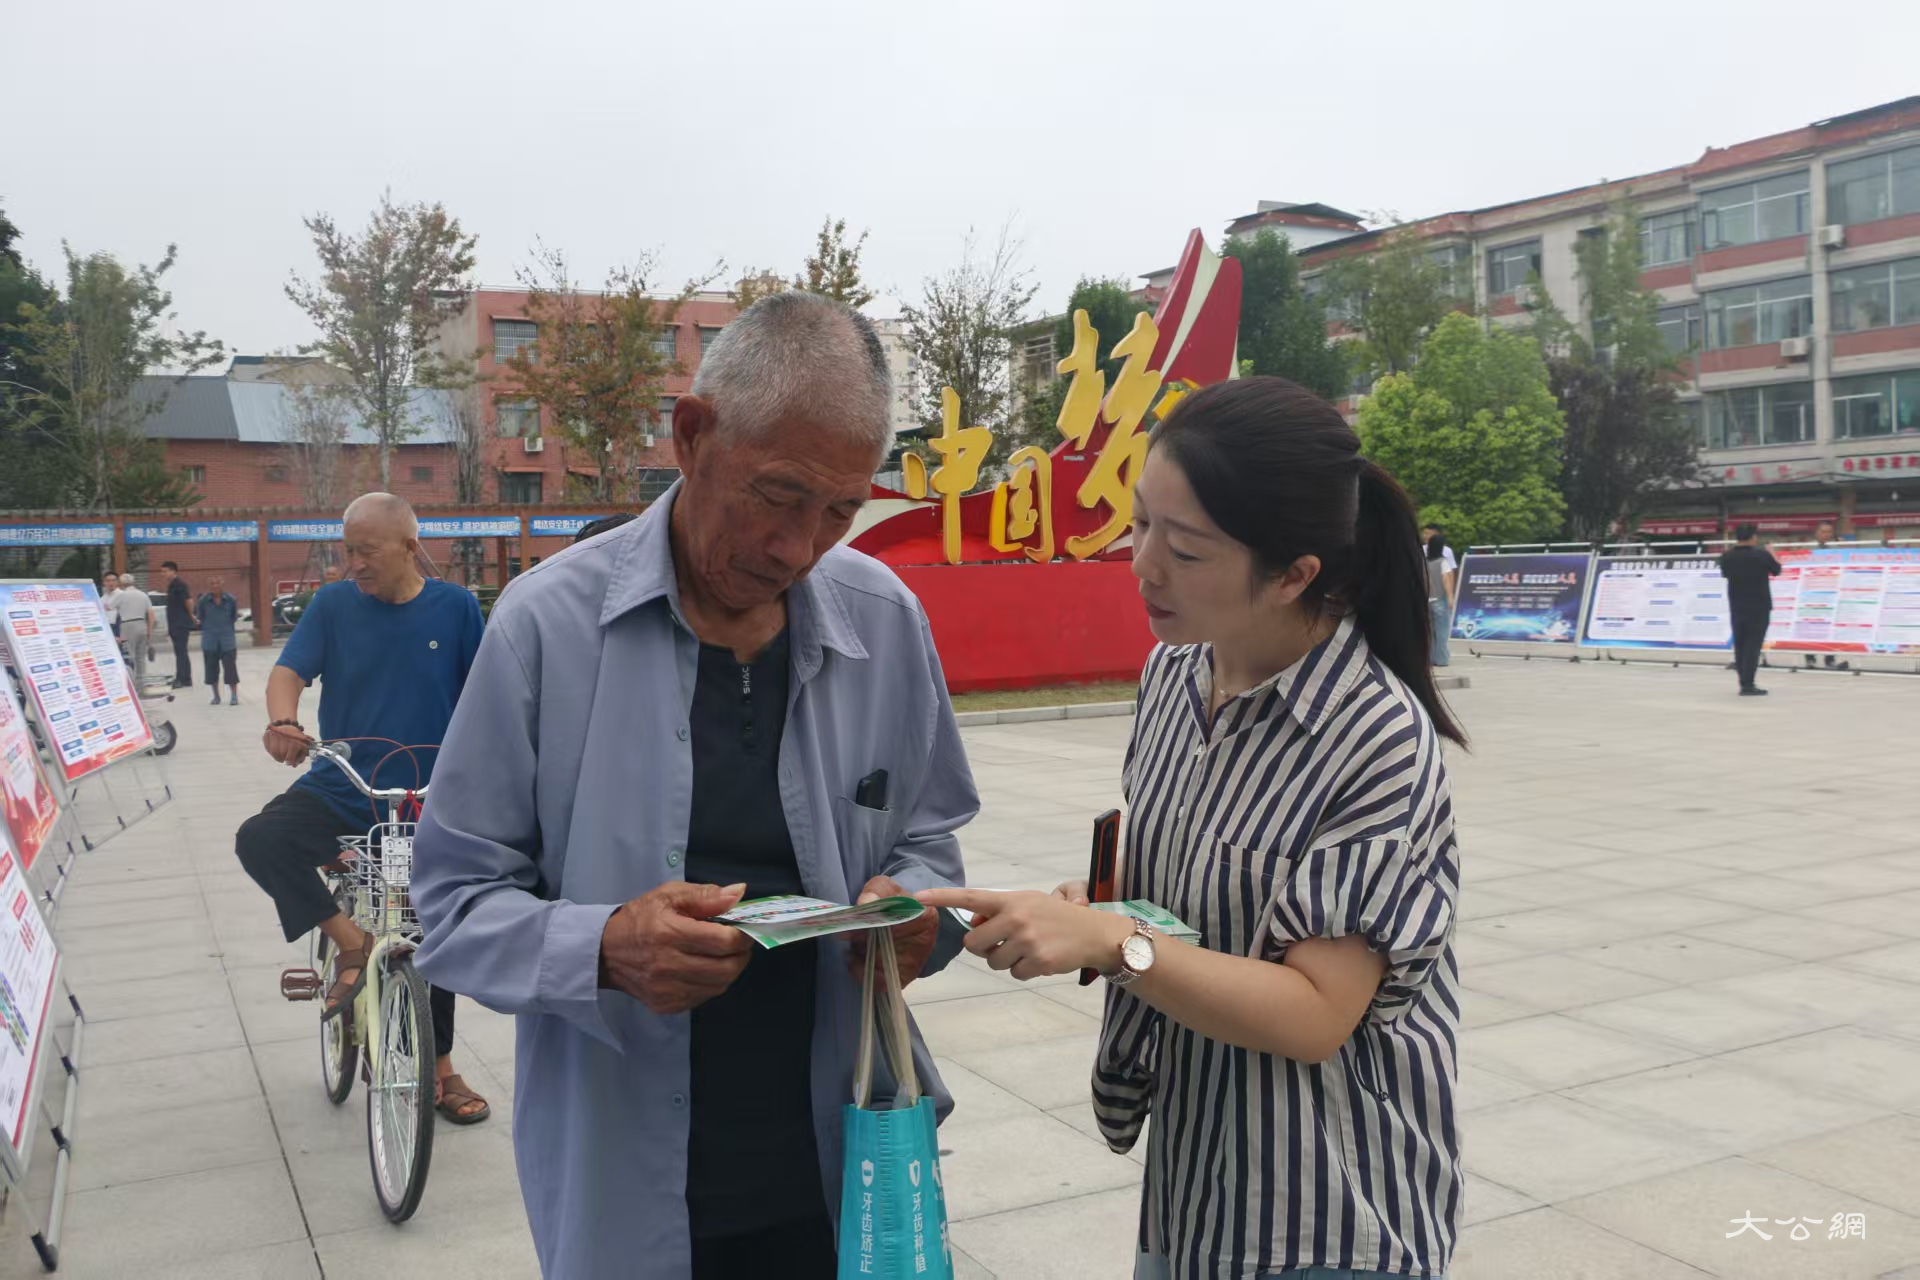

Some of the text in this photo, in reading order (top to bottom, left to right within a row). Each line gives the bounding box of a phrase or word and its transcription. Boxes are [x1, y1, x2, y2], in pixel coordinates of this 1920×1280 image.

[902, 309, 1199, 565] 中国梦
[860, 1192, 873, 1274] 牙齿矫正
[912, 1191, 927, 1274] 牙齿种植
